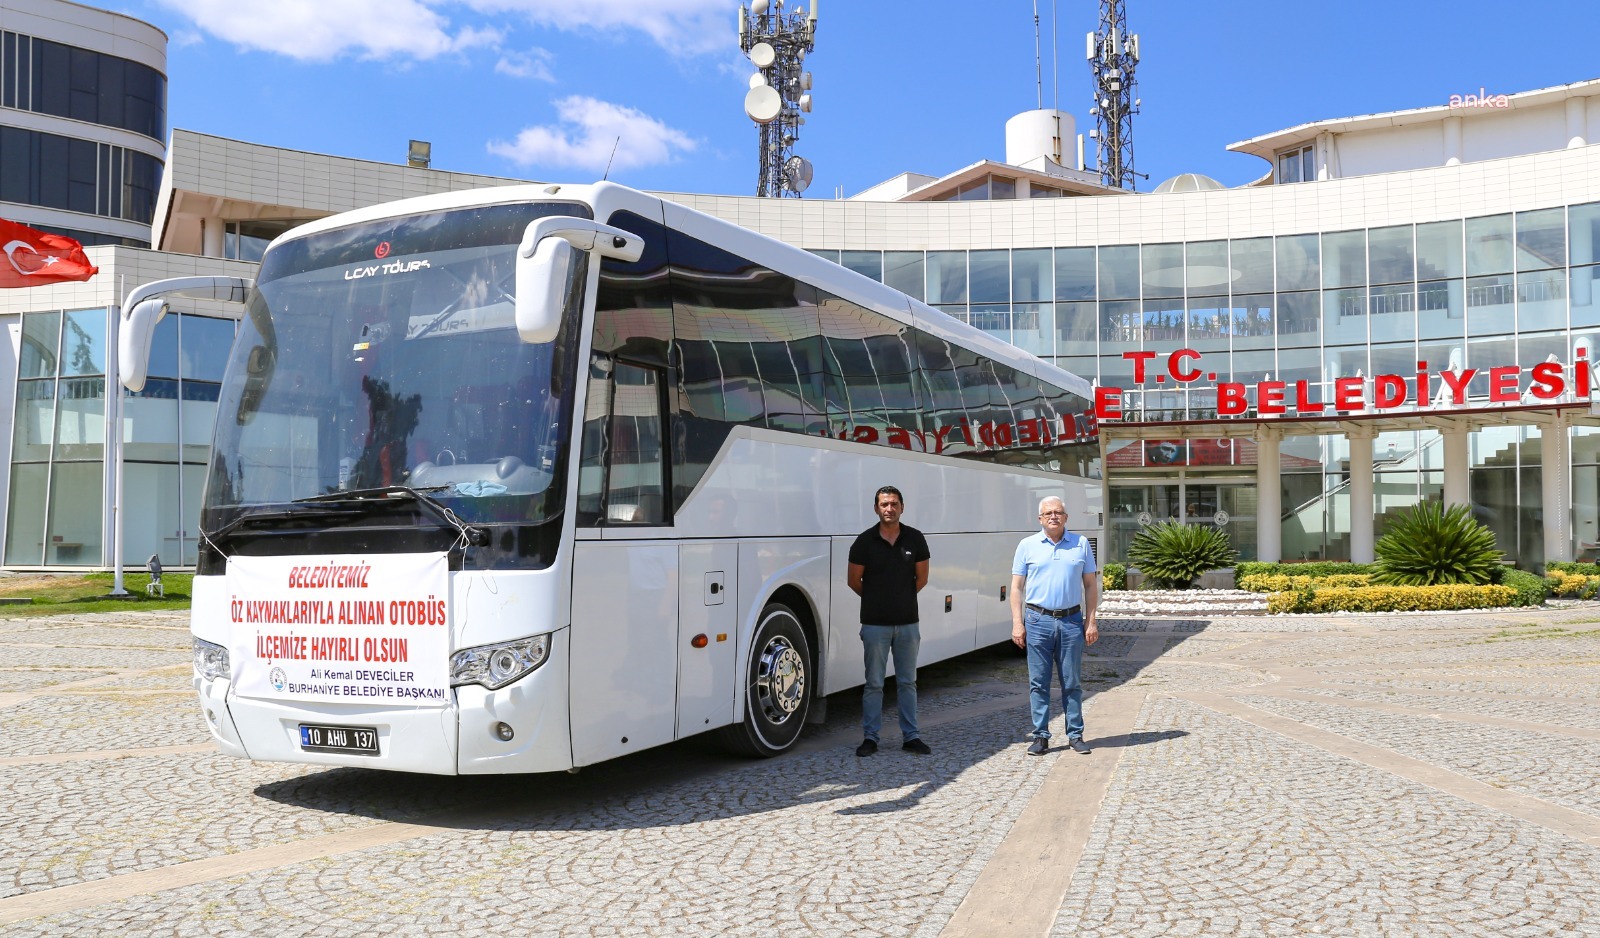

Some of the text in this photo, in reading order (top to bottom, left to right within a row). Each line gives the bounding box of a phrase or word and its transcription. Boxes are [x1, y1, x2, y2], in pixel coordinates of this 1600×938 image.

[1122, 348, 1217, 384] T.C.
[1094, 347, 1590, 419] E BELEDİYESİ
[288, 560, 371, 589] BELEDİYEMİZ
[231, 595, 446, 625] ÖZ KAYNAKLARIYLA ALINAN OTOBÜS
[256, 630, 408, 665] İLÇEMİZE HAYIRLI OLSUN
[310, 668, 414, 682] Ali Kemal DEVECİLER
[288, 682, 445, 700] BURHANİYE BELEDİYE BAŞKANI
[308, 728, 374, 748] 10 AHU 137
